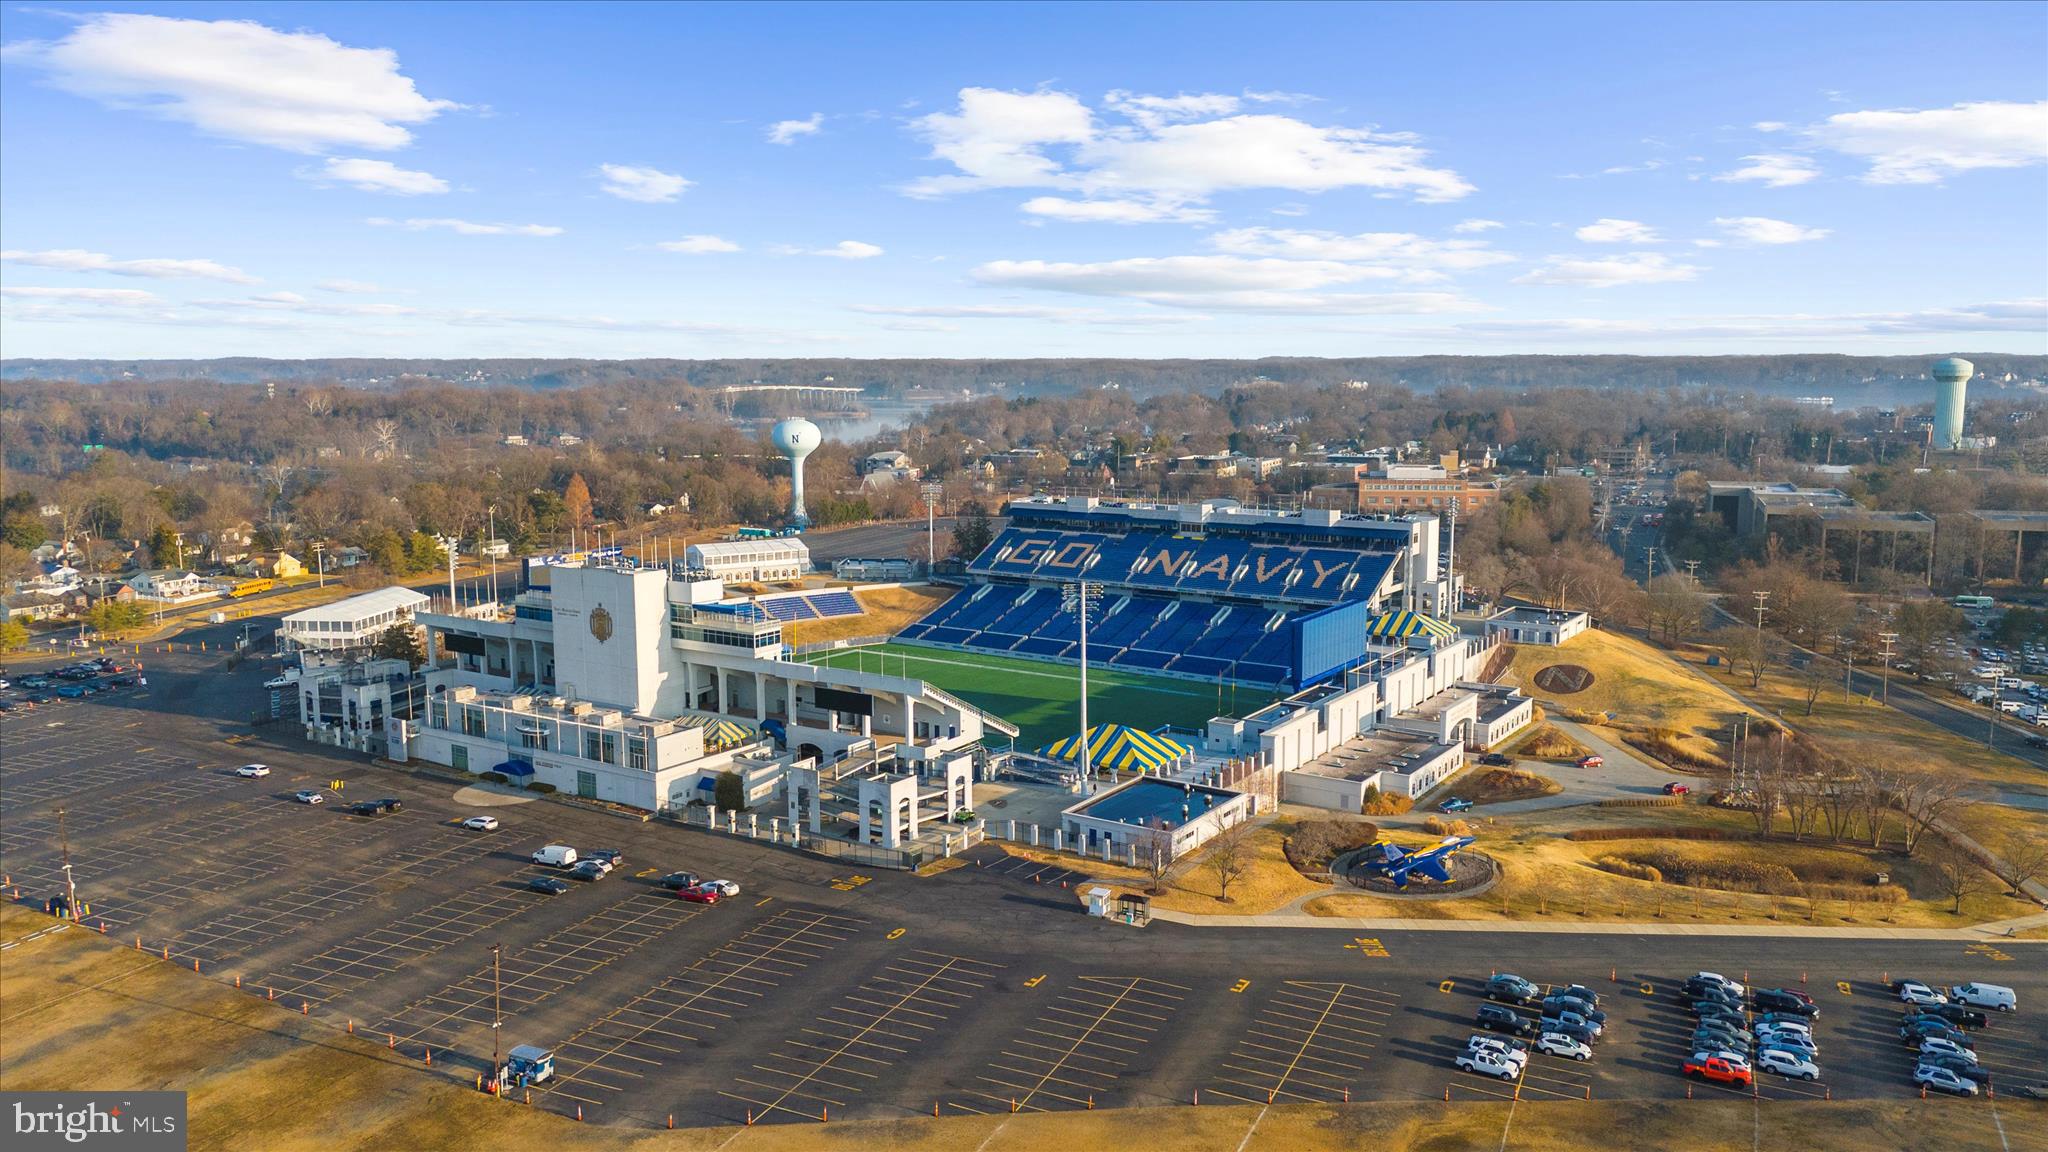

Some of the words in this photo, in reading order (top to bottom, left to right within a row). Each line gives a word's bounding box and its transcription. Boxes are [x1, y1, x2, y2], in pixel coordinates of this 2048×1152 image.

[791, 434, 800, 444] N
[1005, 539, 1095, 568] GO
[1143, 549, 1350, 589] NAVY
[1540, 666, 1589, 689] N
[1023, 974, 1047, 988] F
[1230, 978, 1250, 993] E
